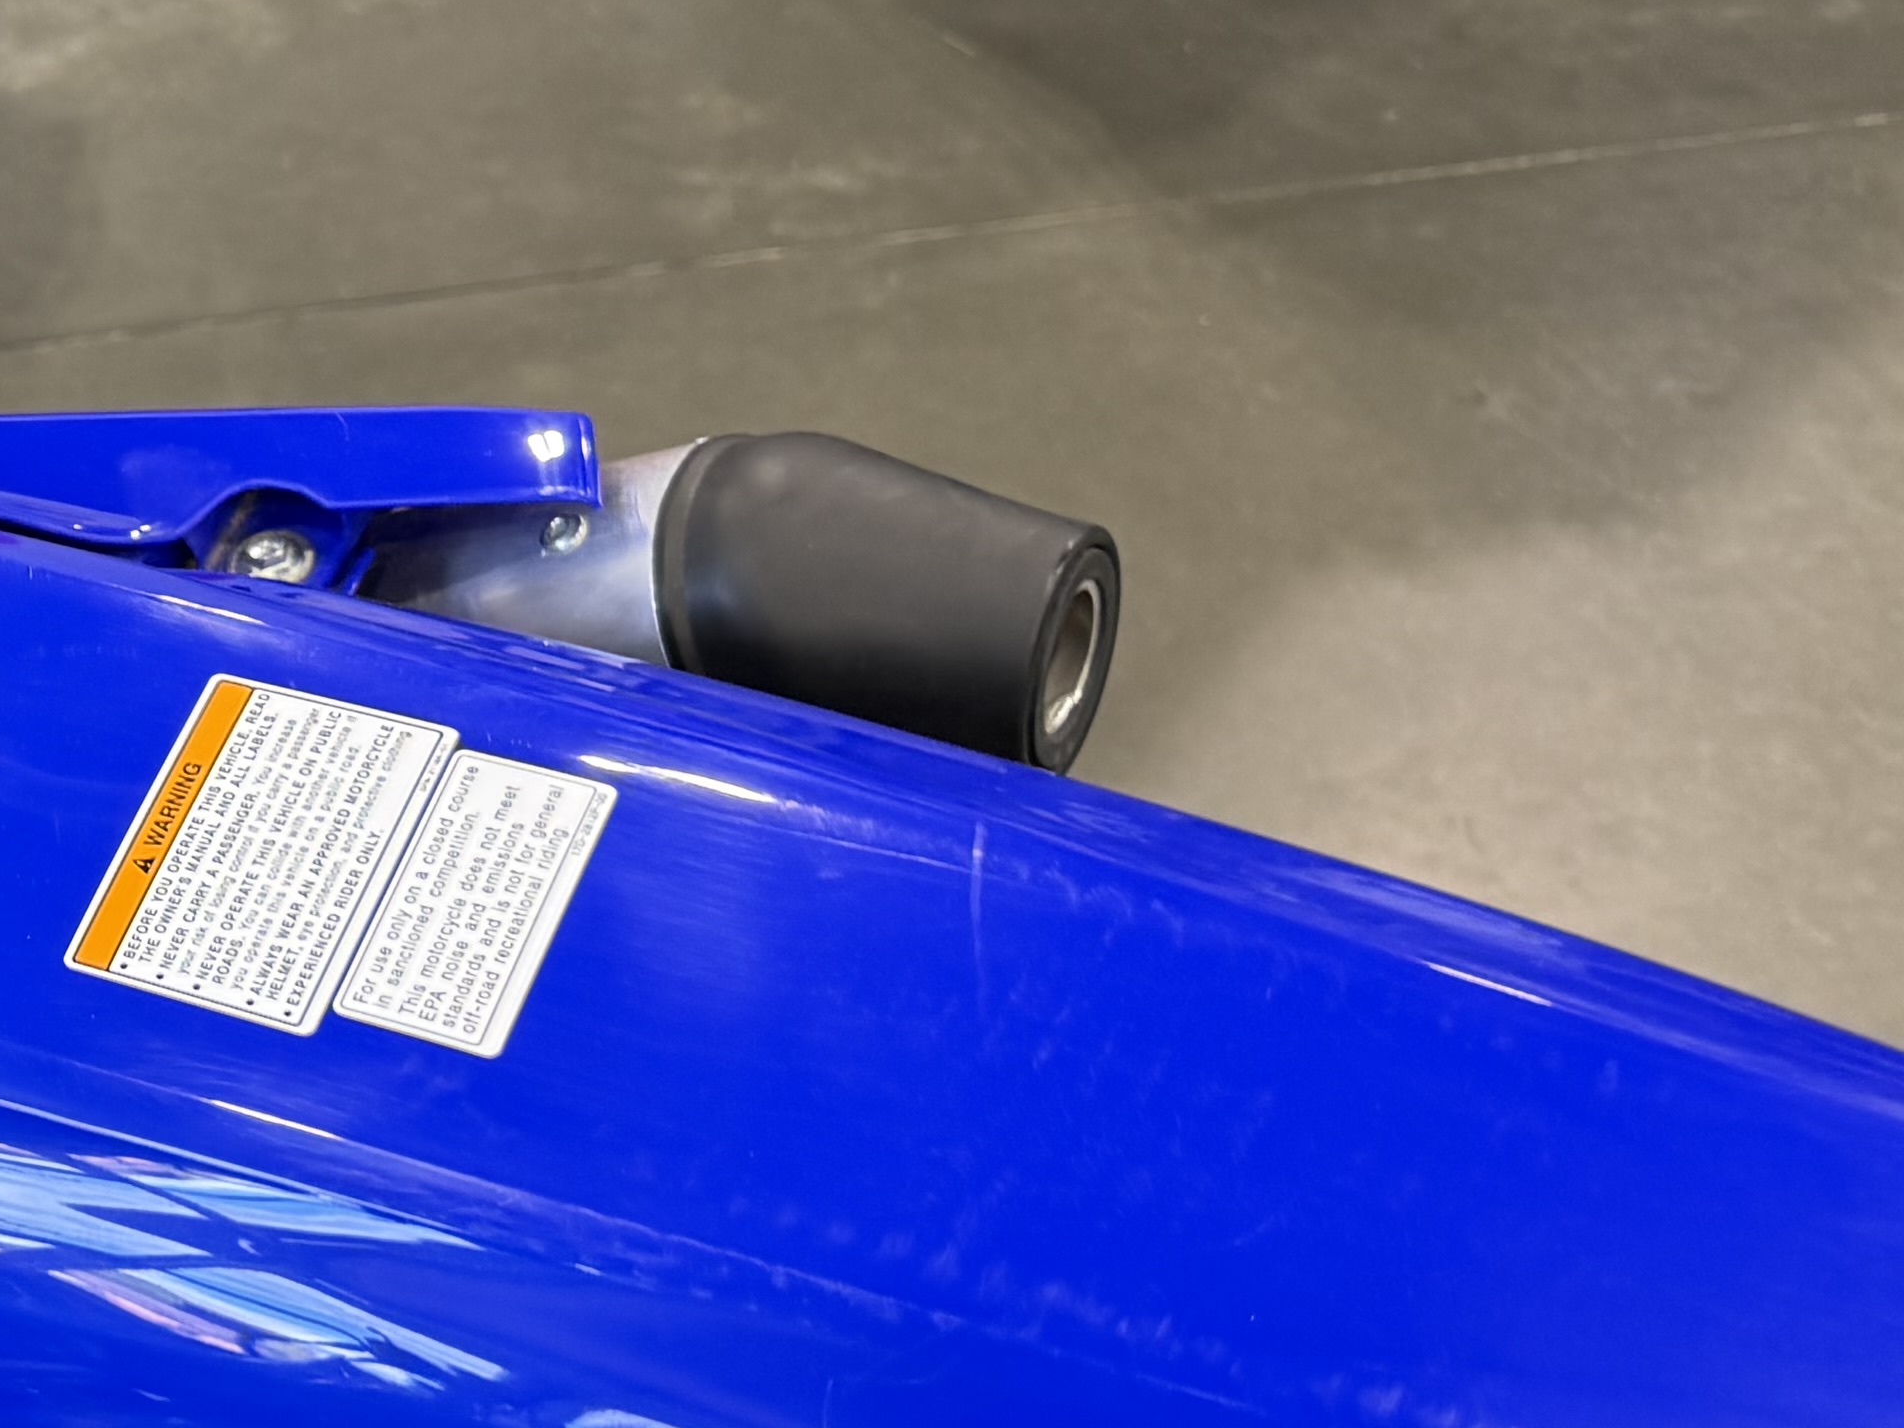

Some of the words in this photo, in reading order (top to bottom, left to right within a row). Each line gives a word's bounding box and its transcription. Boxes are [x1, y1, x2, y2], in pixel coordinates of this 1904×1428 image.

[122, 908, 158, 959] BEFORE
[150, 876, 173, 901] YOU
[166, 816, 204, 872] OPERATE
[197, 785, 221, 811] THIS
[244, 693, 270, 724] READ
[137, 938, 160, 962] THE
[153, 876, 192, 933] OWNER'S
[184, 822, 221, 872] MANUAL
[214, 791, 235, 817] AND
[229, 765, 250, 788] ALL
[243, 713, 278, 760] LABELS.
[142, 762, 202, 845] WARNING
[195, 935, 226, 979] NEVER
[219, 871, 259, 930] OPERATE
[251, 838, 276, 865] THIS
[268, 780, 305, 832] VEHICLE
[309, 711, 341, 754] PUBLIC
[249, 944, 283, 995] ALWAYS
[275, 902, 304, 938] WEAR
[308, 808, 350, 876] APPROVED
[343, 724, 394, 804] MOTORCYCLE
[352, 977, 376, 1003] For
[370, 946, 392, 973] use
[386, 908, 412, 940] only
[422, 817, 454, 864] closed
[447, 765, 479, 812] course
[386, 904, 434, 986] sanctioned
[428, 812, 479, 897] competition.
[397, 984, 426, 1013] This
[419, 898, 466, 977] motorcycle
[459, 856, 486, 891] does
[479, 826, 501, 850] not
[493, 785, 520, 821] meet
[442, 953, 486, 1027] standards
[479, 917, 501, 946] and
[503, 869, 525, 894] not
[514, 843, 535, 864] for
[529, 784, 563, 838] general
[158, 927, 189, 969] NEVER
[182, 880, 211, 922] CARRY
[286, 913, 340, 1006] EXPERIENCED
[333, 869, 363, 909] RIDER
[417, 991, 446, 1021] EPA
[440, 940, 468, 980] noise
[464, 902, 486, 931] and
[481, 822, 524, 893] emissions
[462, 970, 500, 1033] off-road
[493, 875, 543, 964] recreational
